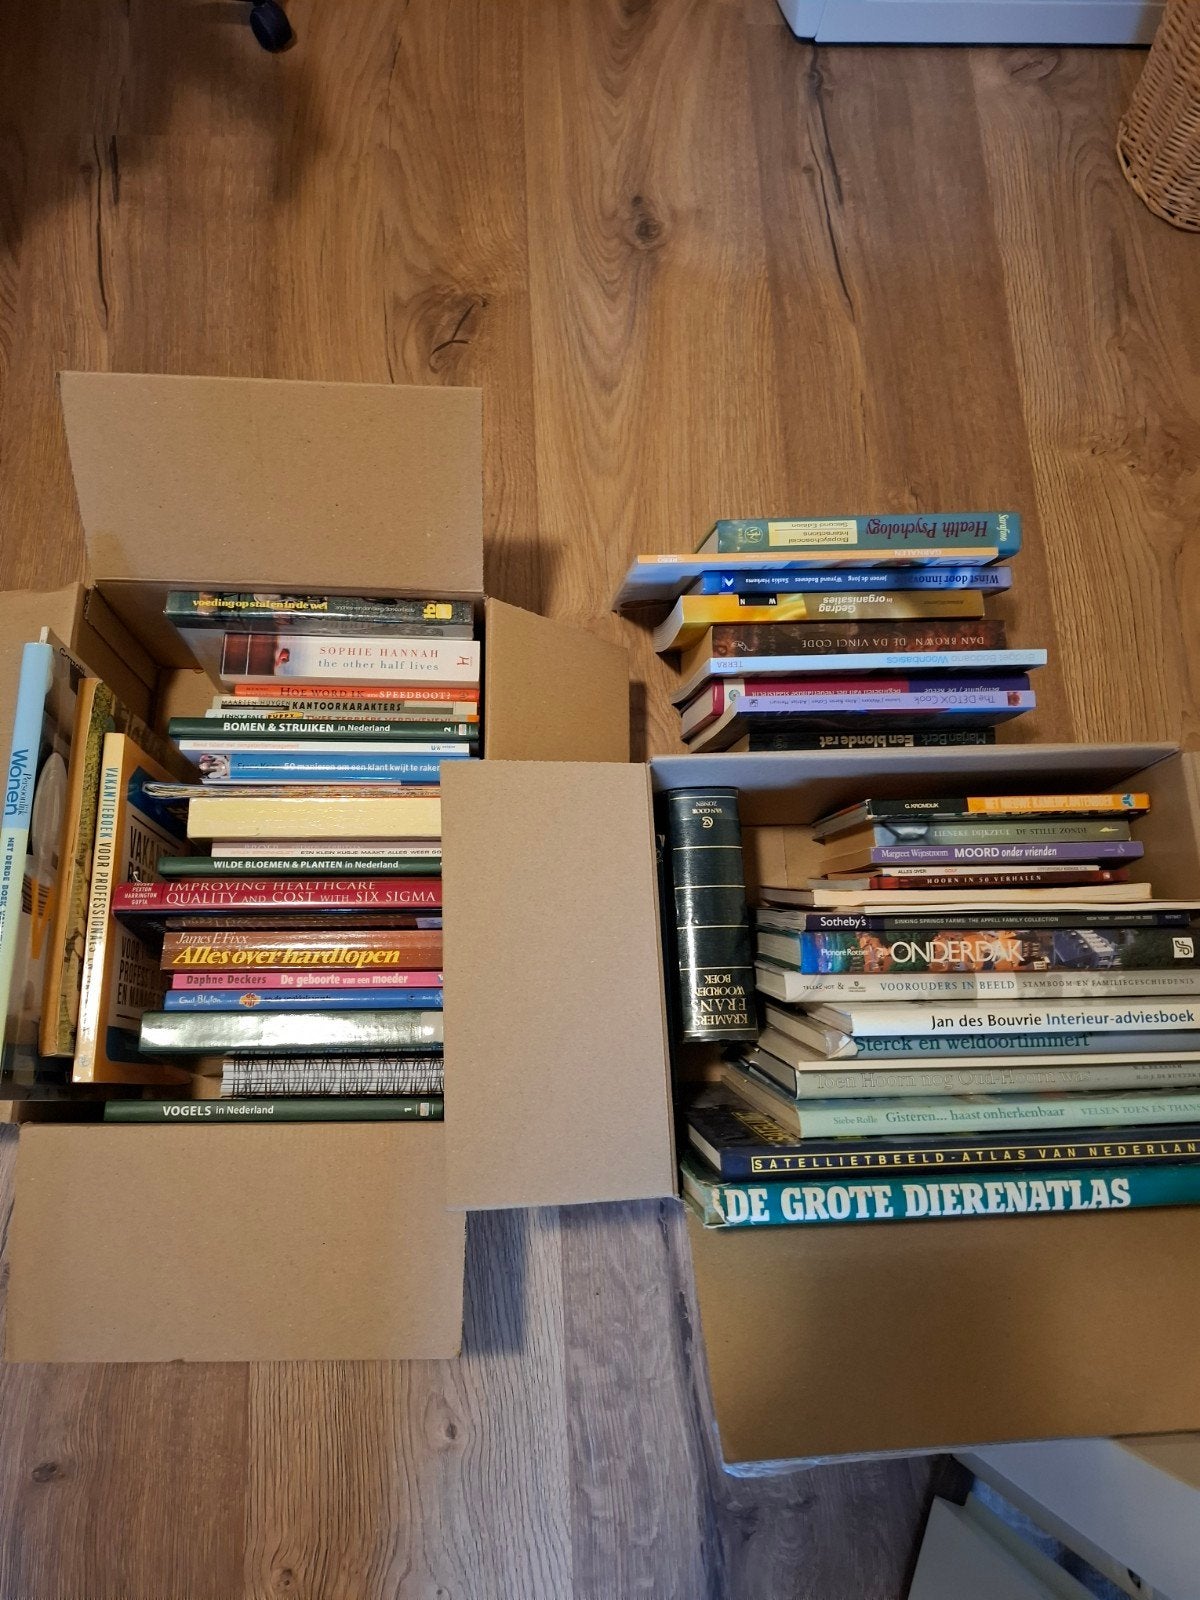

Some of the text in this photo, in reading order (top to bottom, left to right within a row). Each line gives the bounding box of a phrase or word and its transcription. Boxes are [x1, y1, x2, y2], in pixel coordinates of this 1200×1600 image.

[866, 518, 988, 540] Health Psychology
[788, 536, 849, 544] Biopsychosocial
[944, 574, 999, 585] Winst door
[193, 598, 235, 609] voeding
[822, 594, 886, 605] organisaties
[818, 604, 856, 614] Gedrag
[801, 636, 984, 648] DAN BROWN DE DA VINCI CODE
[319, 646, 440, 658] SOPHIE HANNAH
[318, 659, 440, 671] the other half lives
[886, 656, 949, 664] Woonbasics
[280, 687, 308, 697] HOE
[310, 688, 348, 698] WORD
[379, 690, 451, 700] SPEEDBOOT?
[912, 694, 996, 704] The DETOX Cook
[292, 701, 402, 712] KANTOORKARAKTERS
[223, 722, 266, 732] BOMEN
[268, 722, 276, 732] &
[278, 722, 334, 732] STRUIKEN
[348, 724, 391, 732] Nederland
[820, 732, 986, 748] Marjan Berk Een blonde rat
[390, 764, 410, 774] kwijt
[5, 749, 29, 816] Wonen
[18, 774, 32, 816] Persoonlijk
[6, 837, 14, 852] HET
[954, 848, 1000, 858] MOORD
[1002, 847, 1024, 858] onder
[1024, 846, 1057, 856] vrienden
[88, 767, 118, 953] VAKANTIEBOEK VOOR PROFESSIONALS
[214, 860, 243, 868] WILDE
[245, 860, 290, 868] BLOEMEN
[300, 860, 342, 868] PLANTEN
[354, 860, 398, 869] Nederland
[2, 855, 12, 882] DERDE
[168, 881, 376, 892] IMPROVING HEALTHCARE
[0, 885, 9, 906] BOEK
[166, 891, 436, 906] QUALITY AND COST WITH SIX SIGMA
[820, 916, 867, 930] Sotheby's
[176, 932, 250, 944] James Fixx
[172, 946, 400, 968] Alles over hardlopen
[890, 940, 1026, 963] ONDERDAK
[187, 974, 223, 986] Daphne
[227, 975, 266, 984] Deckers
[280, 974, 294, 984] De
[297, 974, 340, 988] geboorte
[372, 974, 408, 984] moeder
[704, 974, 731, 984] BOEK
[1022, 980, 1073, 988] STAMBOOM
[1091, 978, 1194, 987] FAMILIEGESCHIEDENIS
[694, 985, 745, 997] WOORDEN
[880, 981, 1015, 991] VOOROUDERS IN BEELD
[198, 994, 222, 1006] Blyton
[690, 998, 747, 1013] FRANS
[692, 1014, 748, 1026] KRAMERS
[931, 1009, 1195, 1030] Jan des Bouvrie Interieur-adviesboek
[855, 1036, 941, 1052] Sterck en
[862, 1072, 917, 1088] Hoorn
[922, 1074, 954, 1088] nog
[162, 1105, 274, 1116] VOGELS in Nederland
[833, 1116, 856, 1125] Siebe
[950, 1109, 981, 1121] haast
[983, 1106, 1066, 1120] onherkenbaar
[1080, 1106, 1121, 1116] VELSEN
[1122, 1106, 1150, 1114] TOEN
[1152, 1104, 1166, 1113] EN
[1038, 1148, 1076, 1159] VAN
[724, 1178, 1132, 1223] DE GROTE DIERENATLAS
